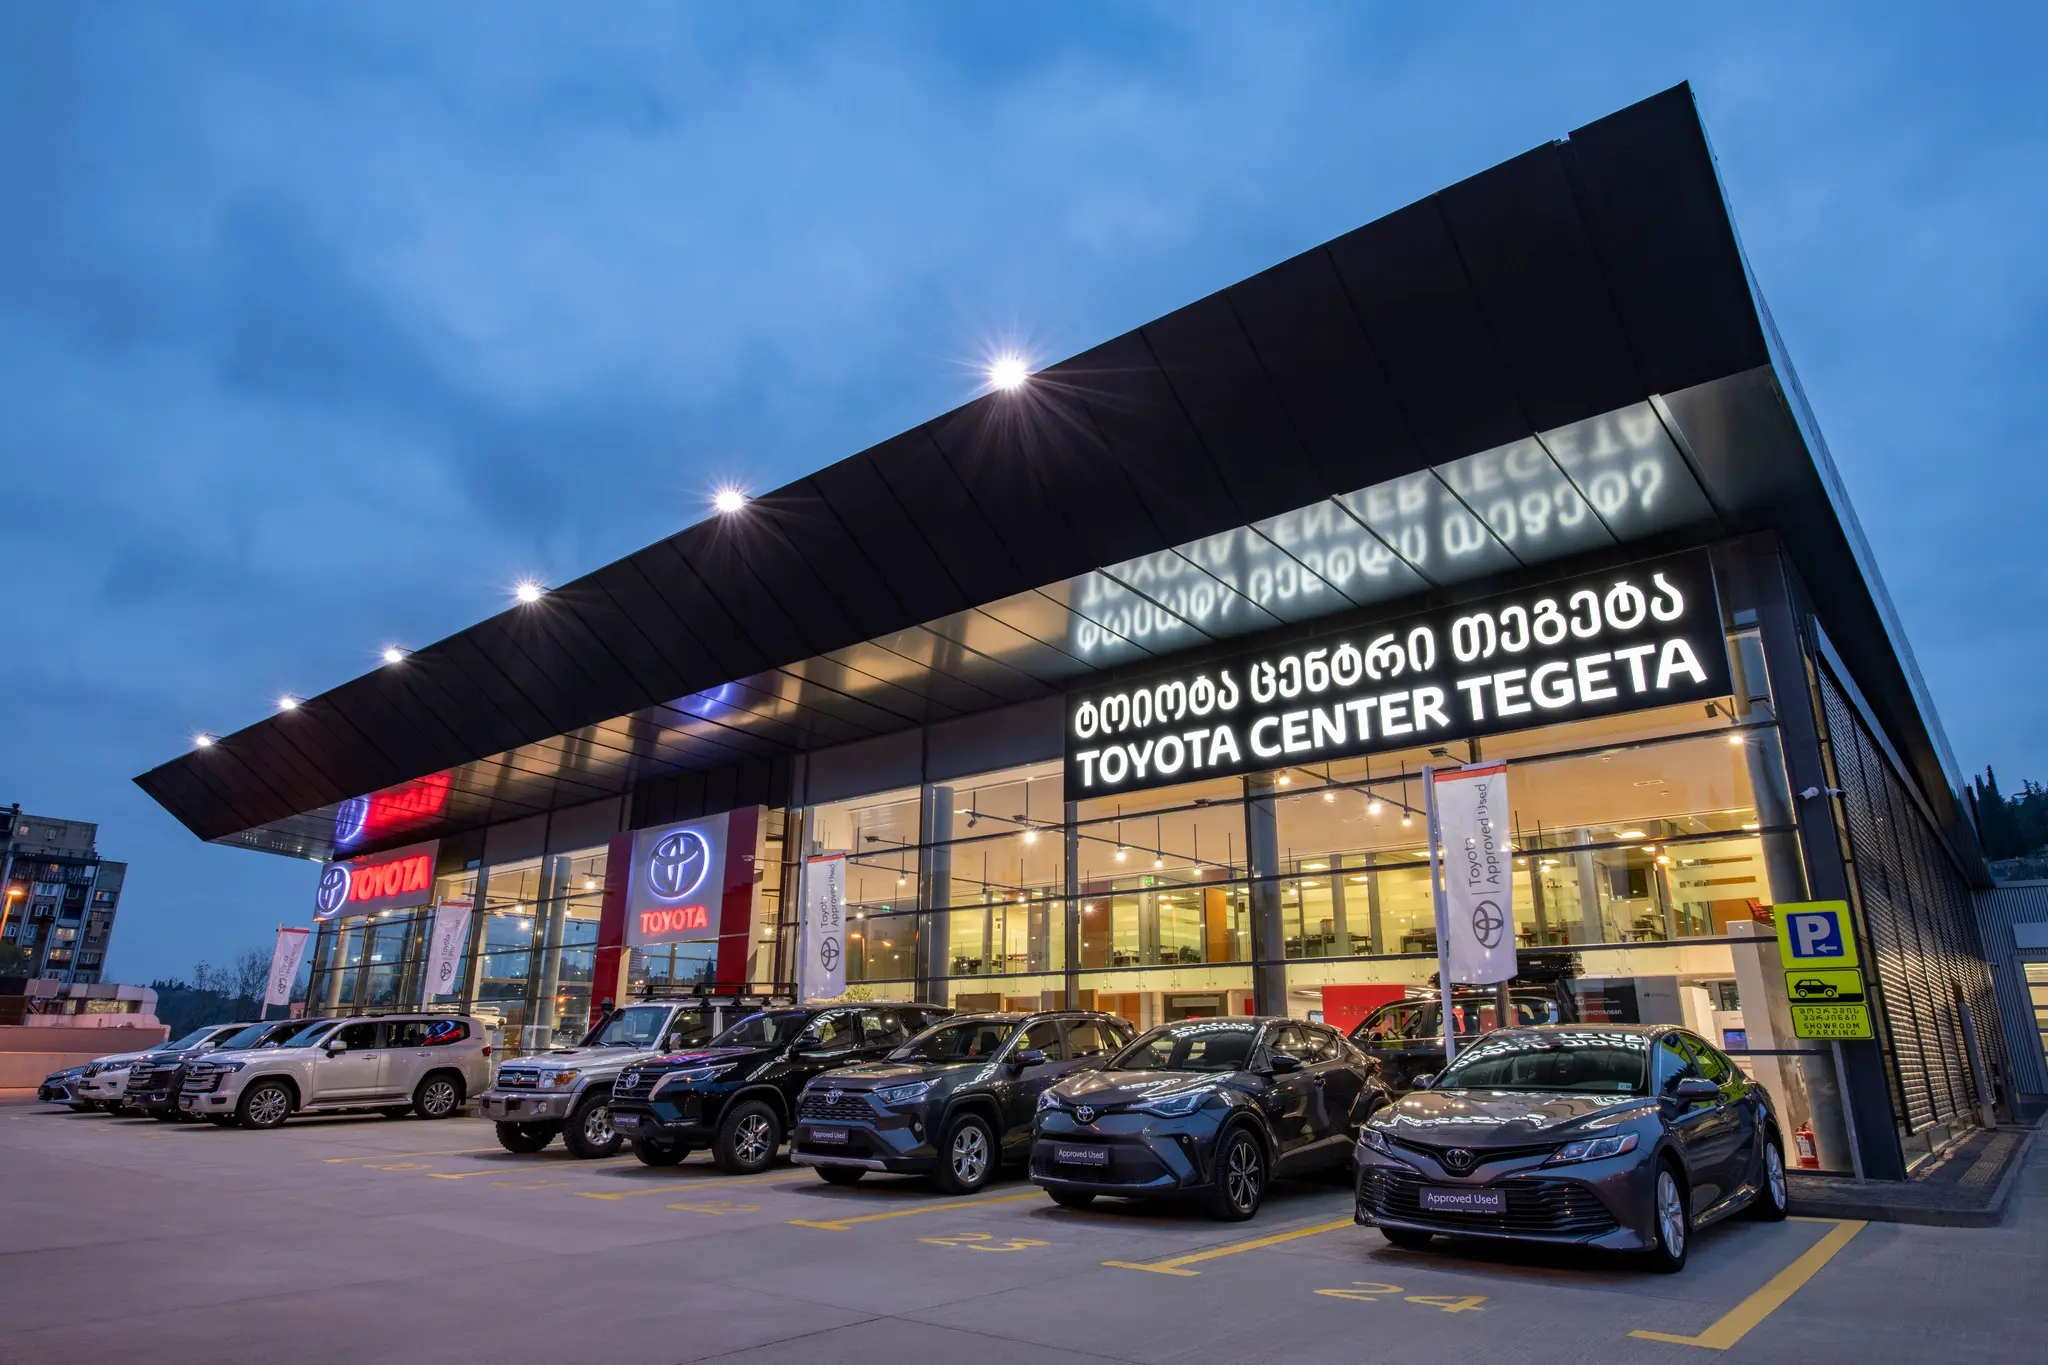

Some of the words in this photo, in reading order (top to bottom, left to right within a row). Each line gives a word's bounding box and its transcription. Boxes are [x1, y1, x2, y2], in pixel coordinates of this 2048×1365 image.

[1075, 669, 1240, 740] ტოიოტა
[1249, 626, 1436, 704] ცენტრი
[1450, 573, 1686, 662] თეგეტა
[1075, 725, 1241, 787] TOYOTA
[1249, 686, 1451, 759] CENTER
[1456, 638, 1708, 722] TEGETA
[1477, 818, 1501, 884] Approved
[349, 856, 431, 900] TOYOTA
[640, 905, 707, 933] TOYOTA
[828, 884, 840, 926] Approved
[1795, 915, 1831, 955] P
[813, 1130, 833, 1139] Approved
[834, 1131, 846, 1139] Used
[1427, 1192, 1471, 1204] Approved
[1474, 1194, 1498, 1205] Used
[917, 1231, 1051, 1252] 23
[1313, 1281, 1489, 1313] 24
